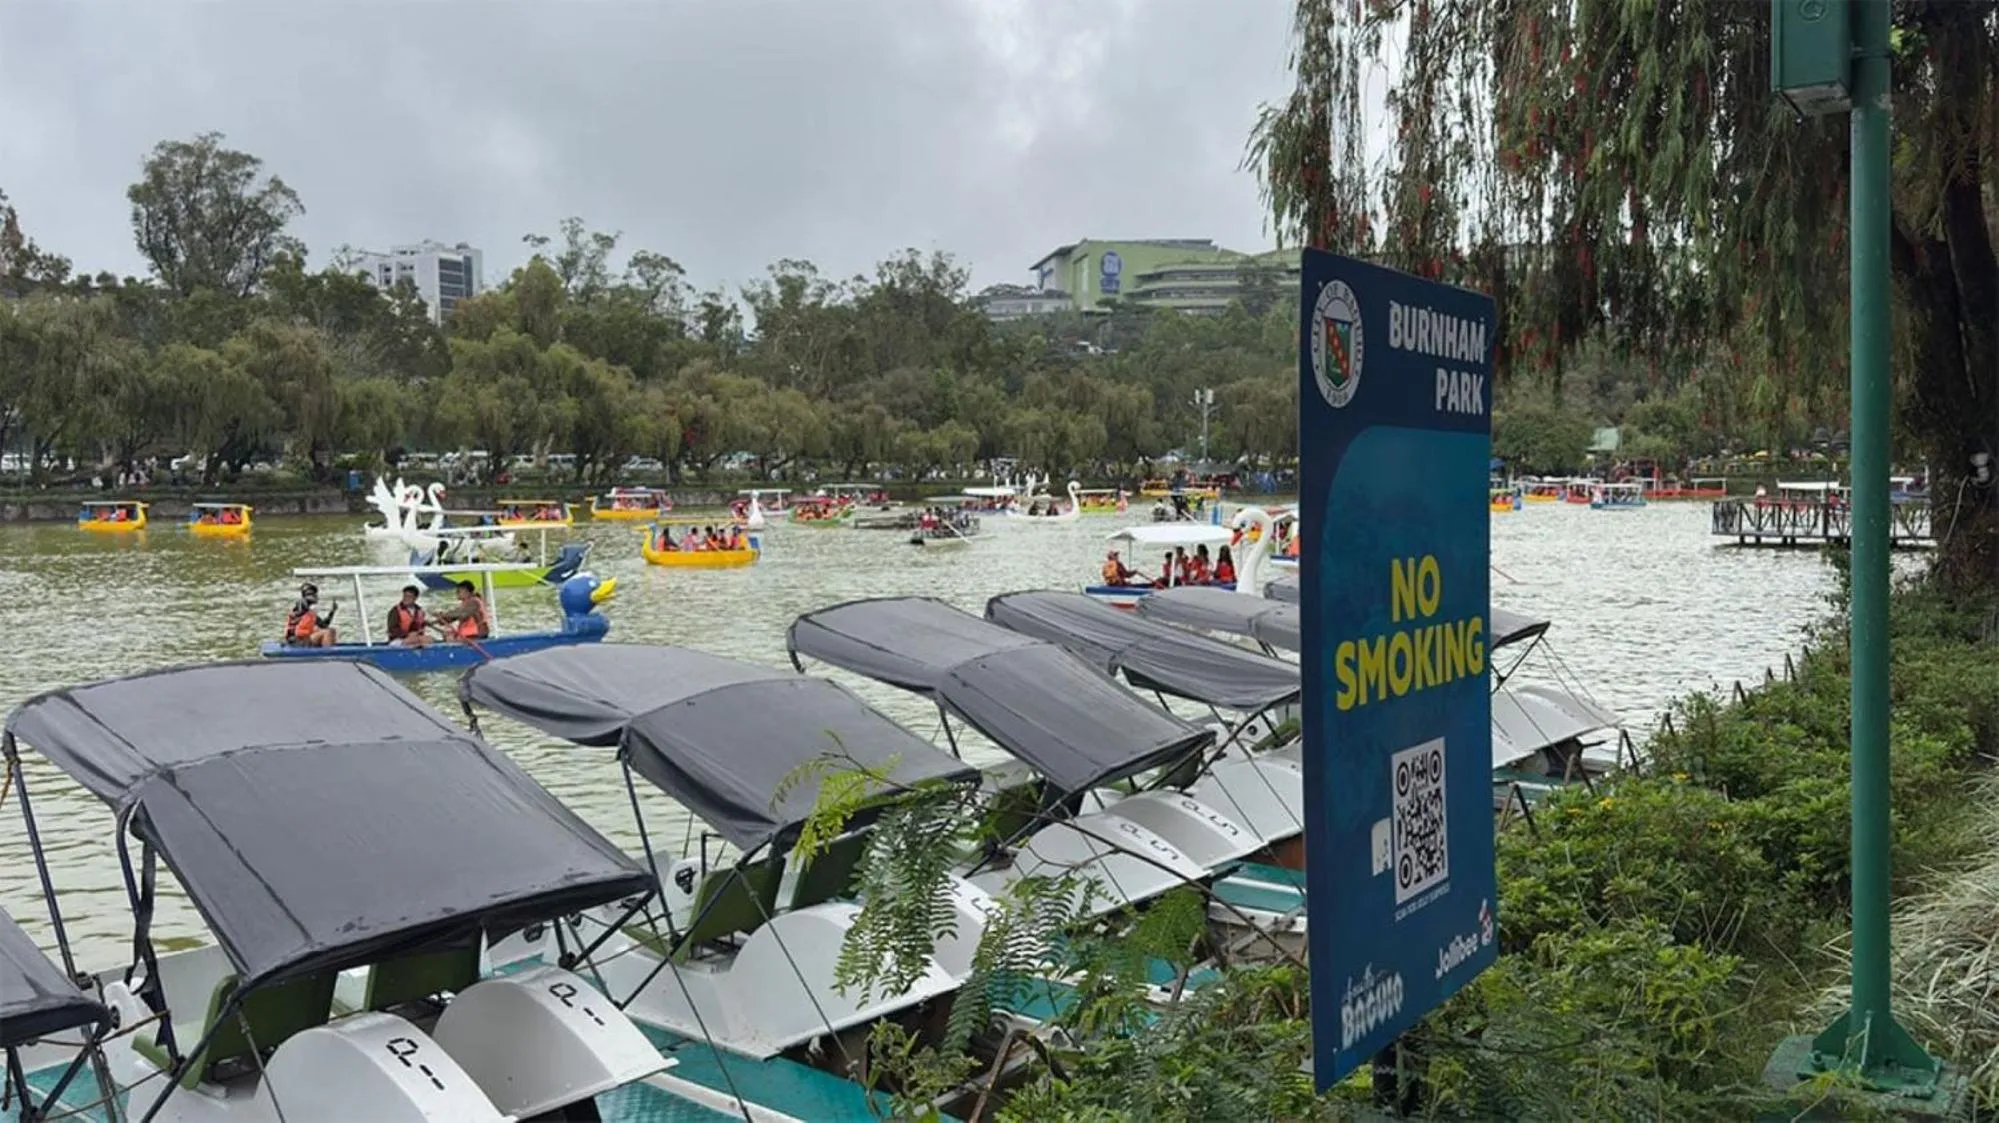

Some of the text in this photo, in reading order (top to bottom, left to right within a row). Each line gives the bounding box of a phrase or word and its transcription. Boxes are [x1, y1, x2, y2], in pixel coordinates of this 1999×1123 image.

[1389, 301, 1486, 364] BURNHAM
[1436, 368, 1484, 415] PARK
[1392, 555, 1441, 622] NO
[1336, 616, 1483, 710] SMOKING
[1435, 933, 1478, 979] Jollibee
[1341, 972, 1403, 1050] BAGUIO
